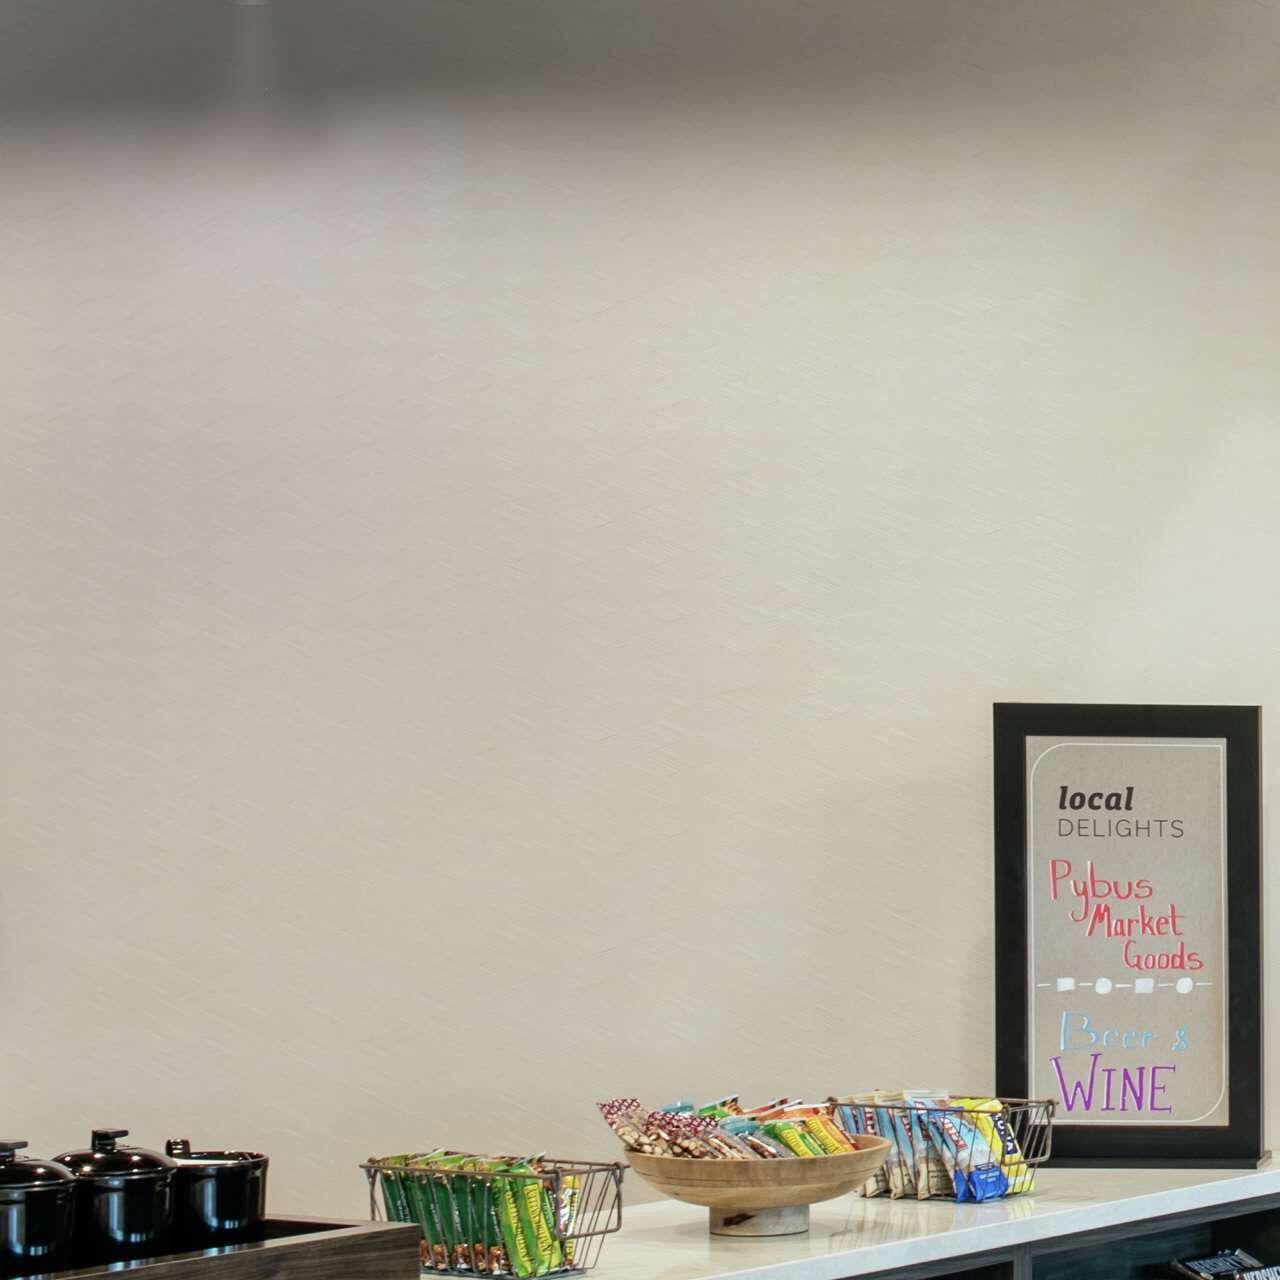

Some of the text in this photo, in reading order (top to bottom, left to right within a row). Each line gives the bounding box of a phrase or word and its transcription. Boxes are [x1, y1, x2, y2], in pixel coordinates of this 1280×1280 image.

[1058, 784, 1134, 813] local
[1057, 818, 1184, 840] DELIGHTS
[1048, 858, 1154, 922] Pybus
[1086, 903, 1186, 939] Market
[1122, 940, 1204, 971] Goods
[1059, 1009, 1161, 1051] Beer
[1050, 1052, 1176, 1114] WINE
